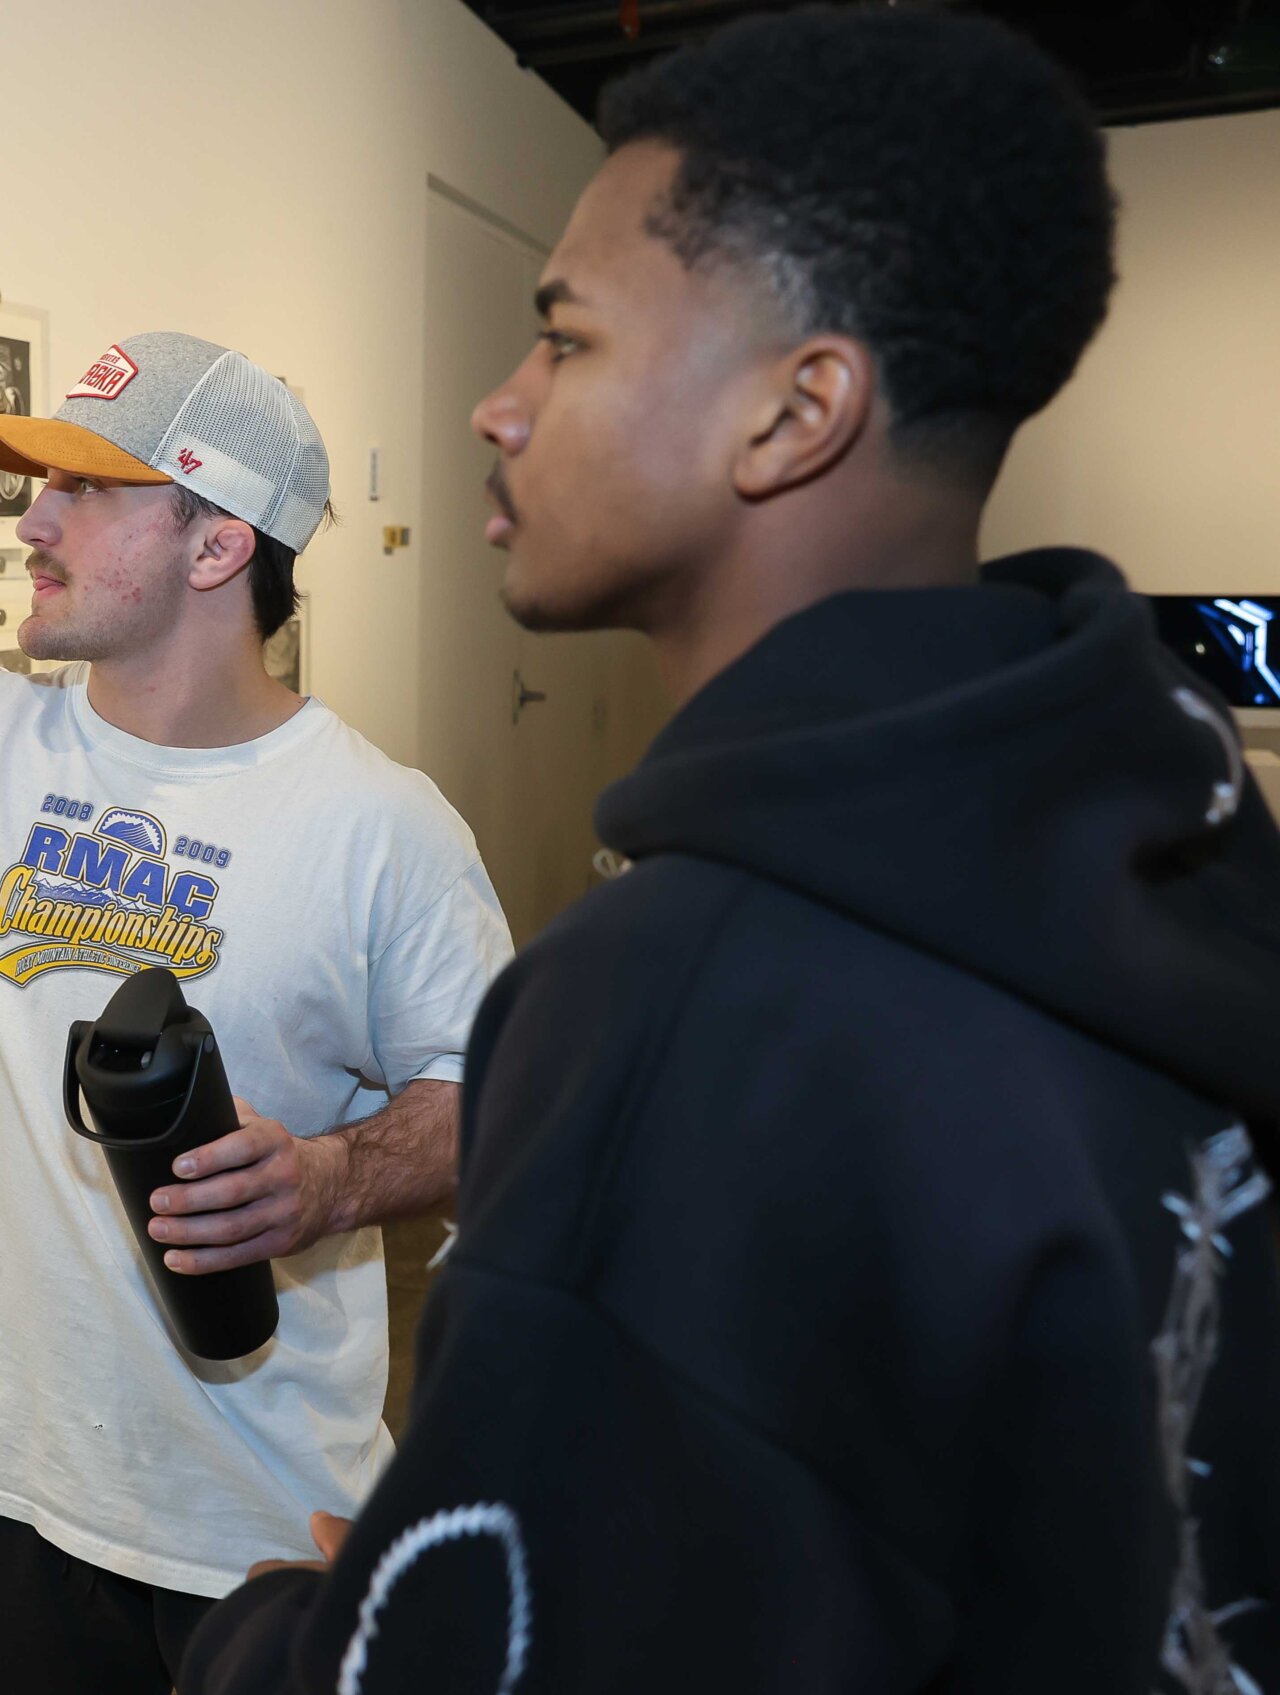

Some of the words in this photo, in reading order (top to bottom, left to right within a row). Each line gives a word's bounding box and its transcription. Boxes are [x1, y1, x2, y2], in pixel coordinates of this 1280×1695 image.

[41, 794, 94, 821] 2008
[173, 835, 232, 868] 2009
[21, 823, 218, 920] RMAC
[34, 947, 73, 967] MOUNTAIN
[72, 948, 106, 964] ATHLETIC
[106, 954, 141, 973] CONFERENCE
